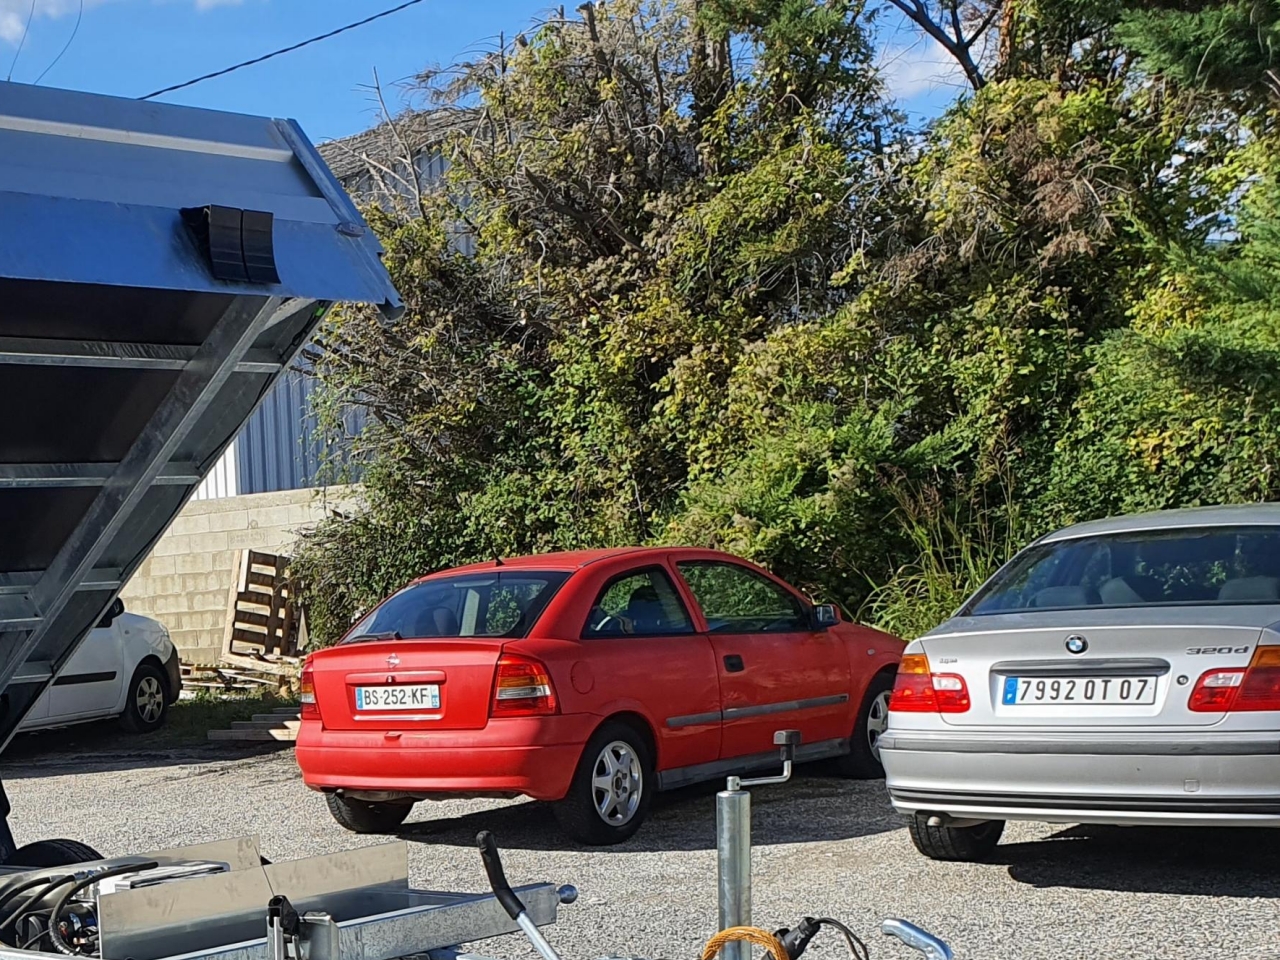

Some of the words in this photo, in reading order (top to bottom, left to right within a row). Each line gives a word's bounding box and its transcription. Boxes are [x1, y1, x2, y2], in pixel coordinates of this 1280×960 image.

[1185, 645, 1250, 656] 320d
[364, 687, 429, 706] BS-252-KF
[1020, 680, 1076, 701] 7992
[1119, 679, 1148, 701] 07
